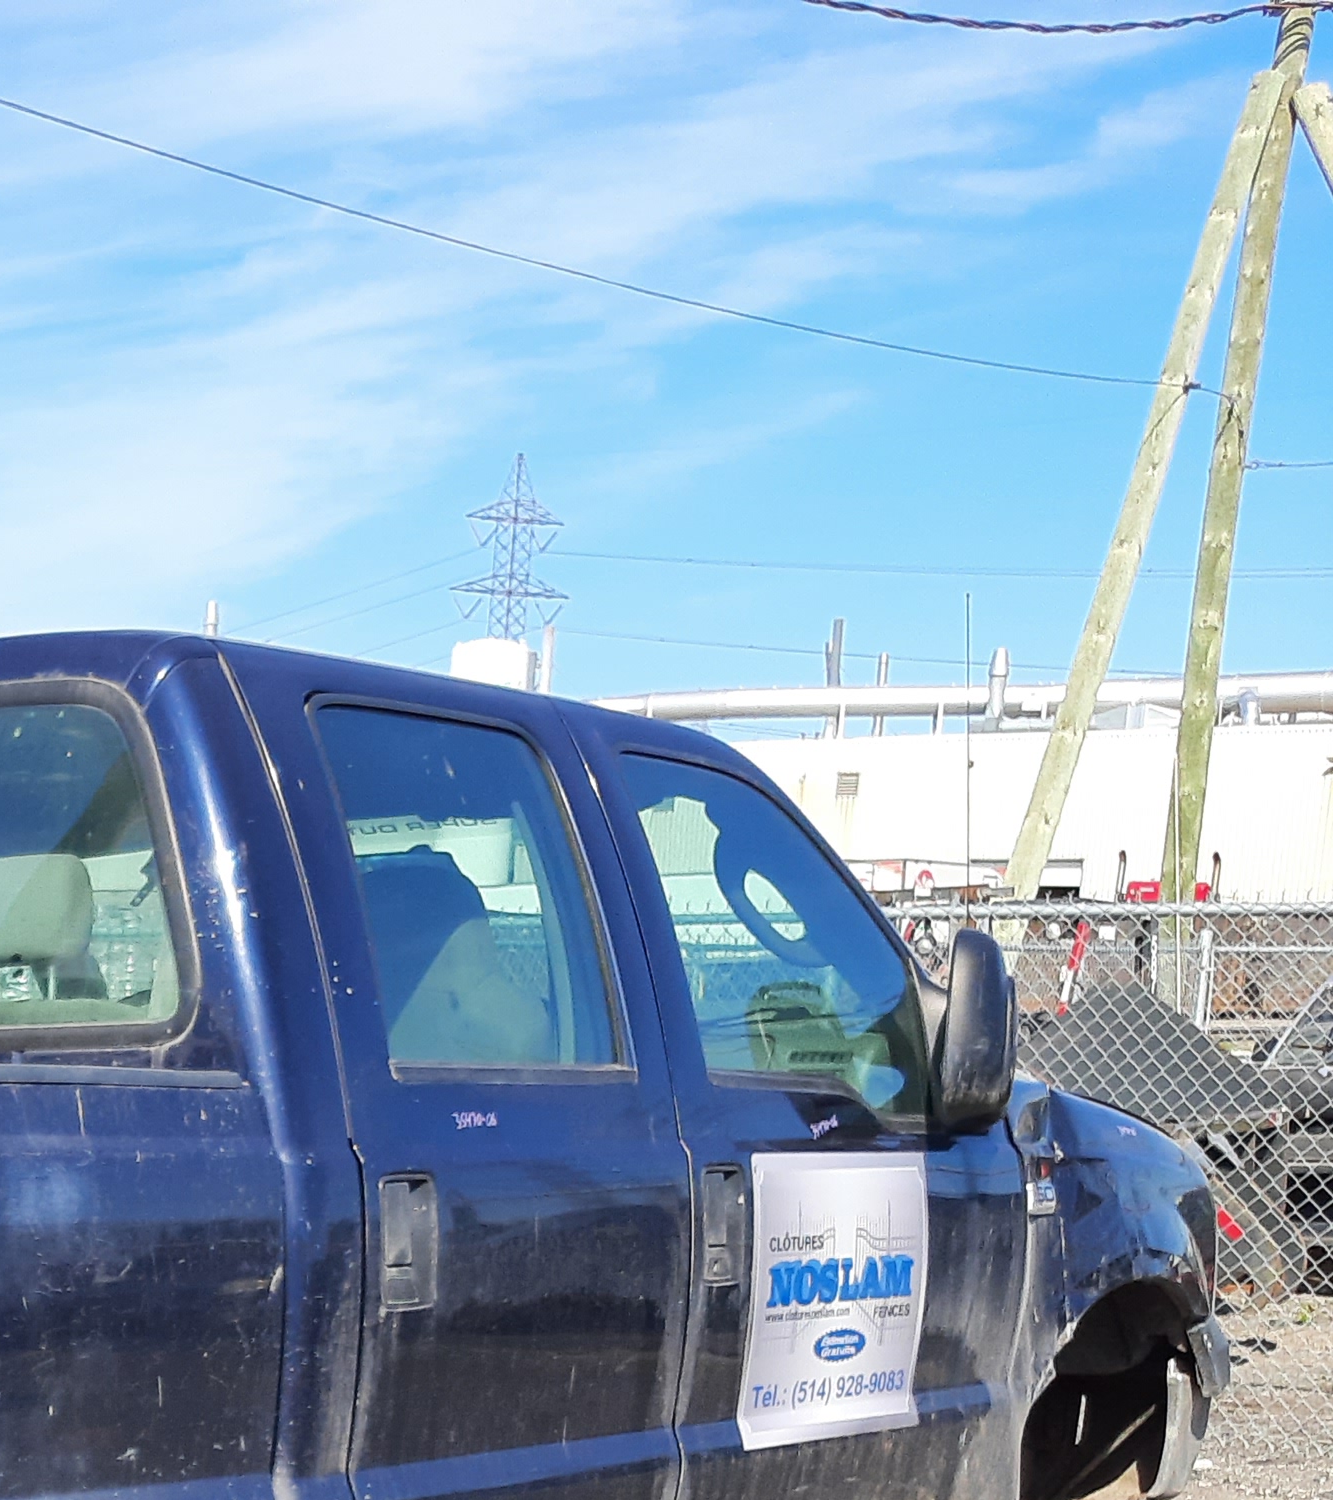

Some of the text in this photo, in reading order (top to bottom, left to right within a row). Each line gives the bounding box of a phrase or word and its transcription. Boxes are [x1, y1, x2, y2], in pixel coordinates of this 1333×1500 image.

[766, 1254, 915, 1308] NOSLAM
[873, 1303, 910, 1319] FENCES
[791, 1376, 832, 1409] (514)
[835, 1369, 904, 1398] 928-9083
